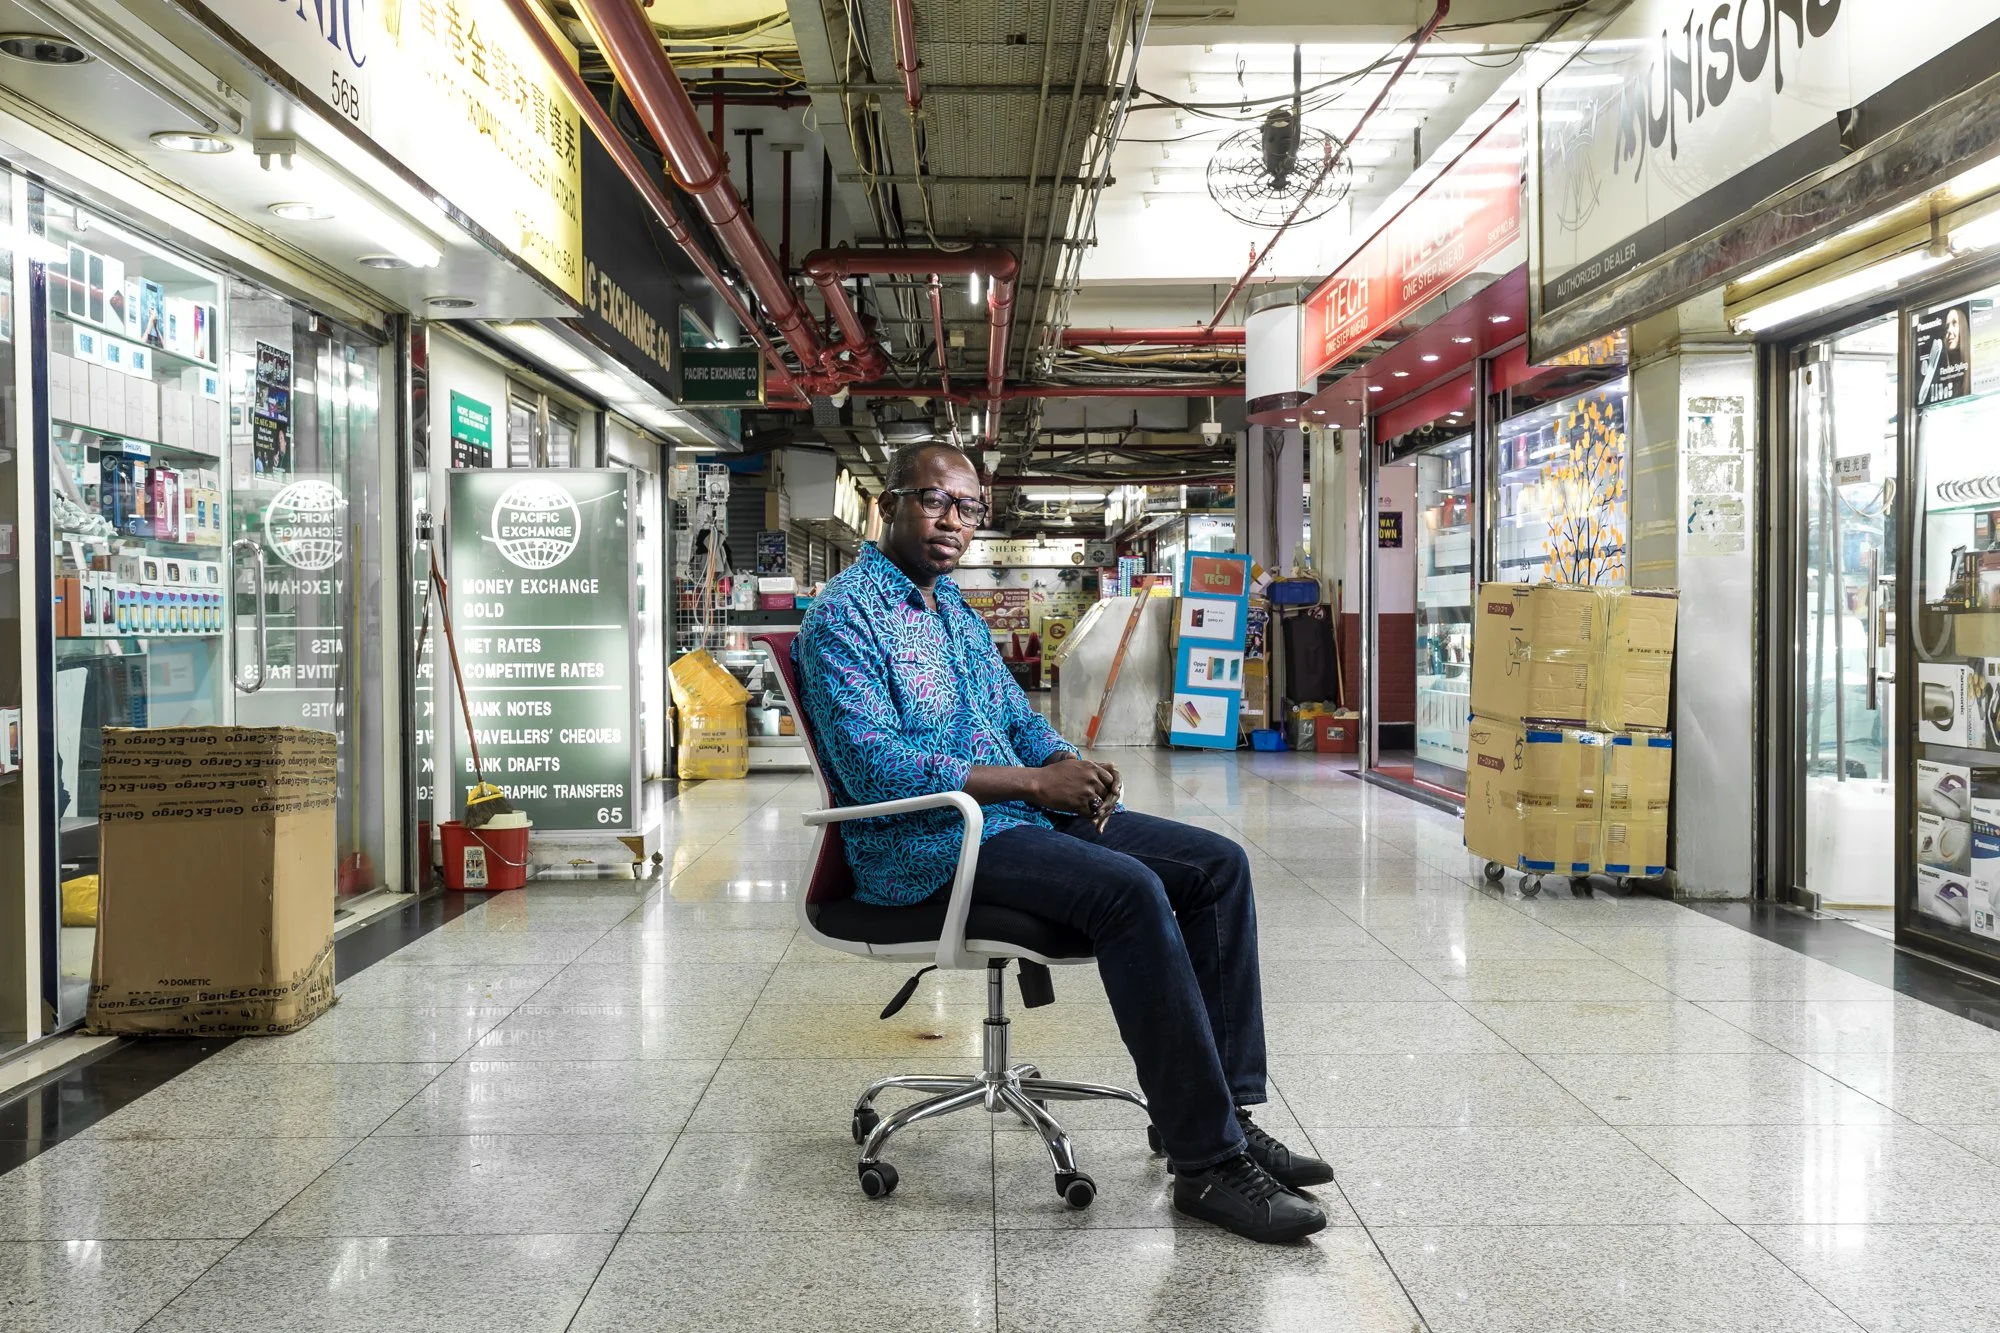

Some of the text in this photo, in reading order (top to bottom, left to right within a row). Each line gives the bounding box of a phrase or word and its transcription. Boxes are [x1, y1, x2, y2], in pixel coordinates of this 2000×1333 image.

[331, 69, 360, 122] 56B
[1402, 244, 1465, 301] ONE STEP AHEAD
[1556, 242, 1637, 298] AUTHORIZED DEALER
[1325, 262, 1369, 334] iTECH
[600, 270, 656, 361] EXCHANGE
[657, 326, 671, 373] CO
[1325, 314, 1369, 356] ONE STEP AHEAD
[684, 367, 757, 380] PACIFIC EXCHANGE CO
[124, 443, 143, 453] PHILIPS
[510, 512, 560, 523] PACIFIC
[1380, 518, 1395, 527] WAY
[501, 526, 572, 538] EXCHANGE
[1204, 573, 1231, 586] TECH
[462, 578, 599, 595] MONEY EXCHANGE
[463, 602, 505, 618] GOLD
[464, 638, 542, 655] NET RATES
[464, 662, 604, 679] COMPETITIVE RATES
[466, 701, 552, 717] BANK NOTES
[124, 734, 217, 746] Gen-Ex Cargo
[225, 734, 267, 744] Cargo
[559, 728, 622, 744] CHEQUES
[100, 757, 192, 767] Gen-Ex Cargo
[200, 757, 285, 768] Gen-Ex Cargo
[465, 757, 561, 772] BANK DRAFTS
[1918, 763, 1940, 773] Panasonic
[119, 781, 167, 792] Gen-Ex
[175, 778, 267, 790] Gen-Ex Cargo
[465, 783, 624, 799] TGRAPHIC TRANSFERS
[152, 805, 244, 818] Gen-Ex Cargo
[252, 802, 286, 813] Cargo
[596, 807, 623, 824] 65
[1919, 815, 1940, 826] Panasonic
[1974, 839, 1999, 851] Panasonic
[1918, 867, 1940, 879] Panasonic
[170, 978, 212, 987] DOMETIC
[198, 985, 288, 1002] Gen-Ex Cargo
[99, 995, 190, 1009] Gen-Ex Cargo
